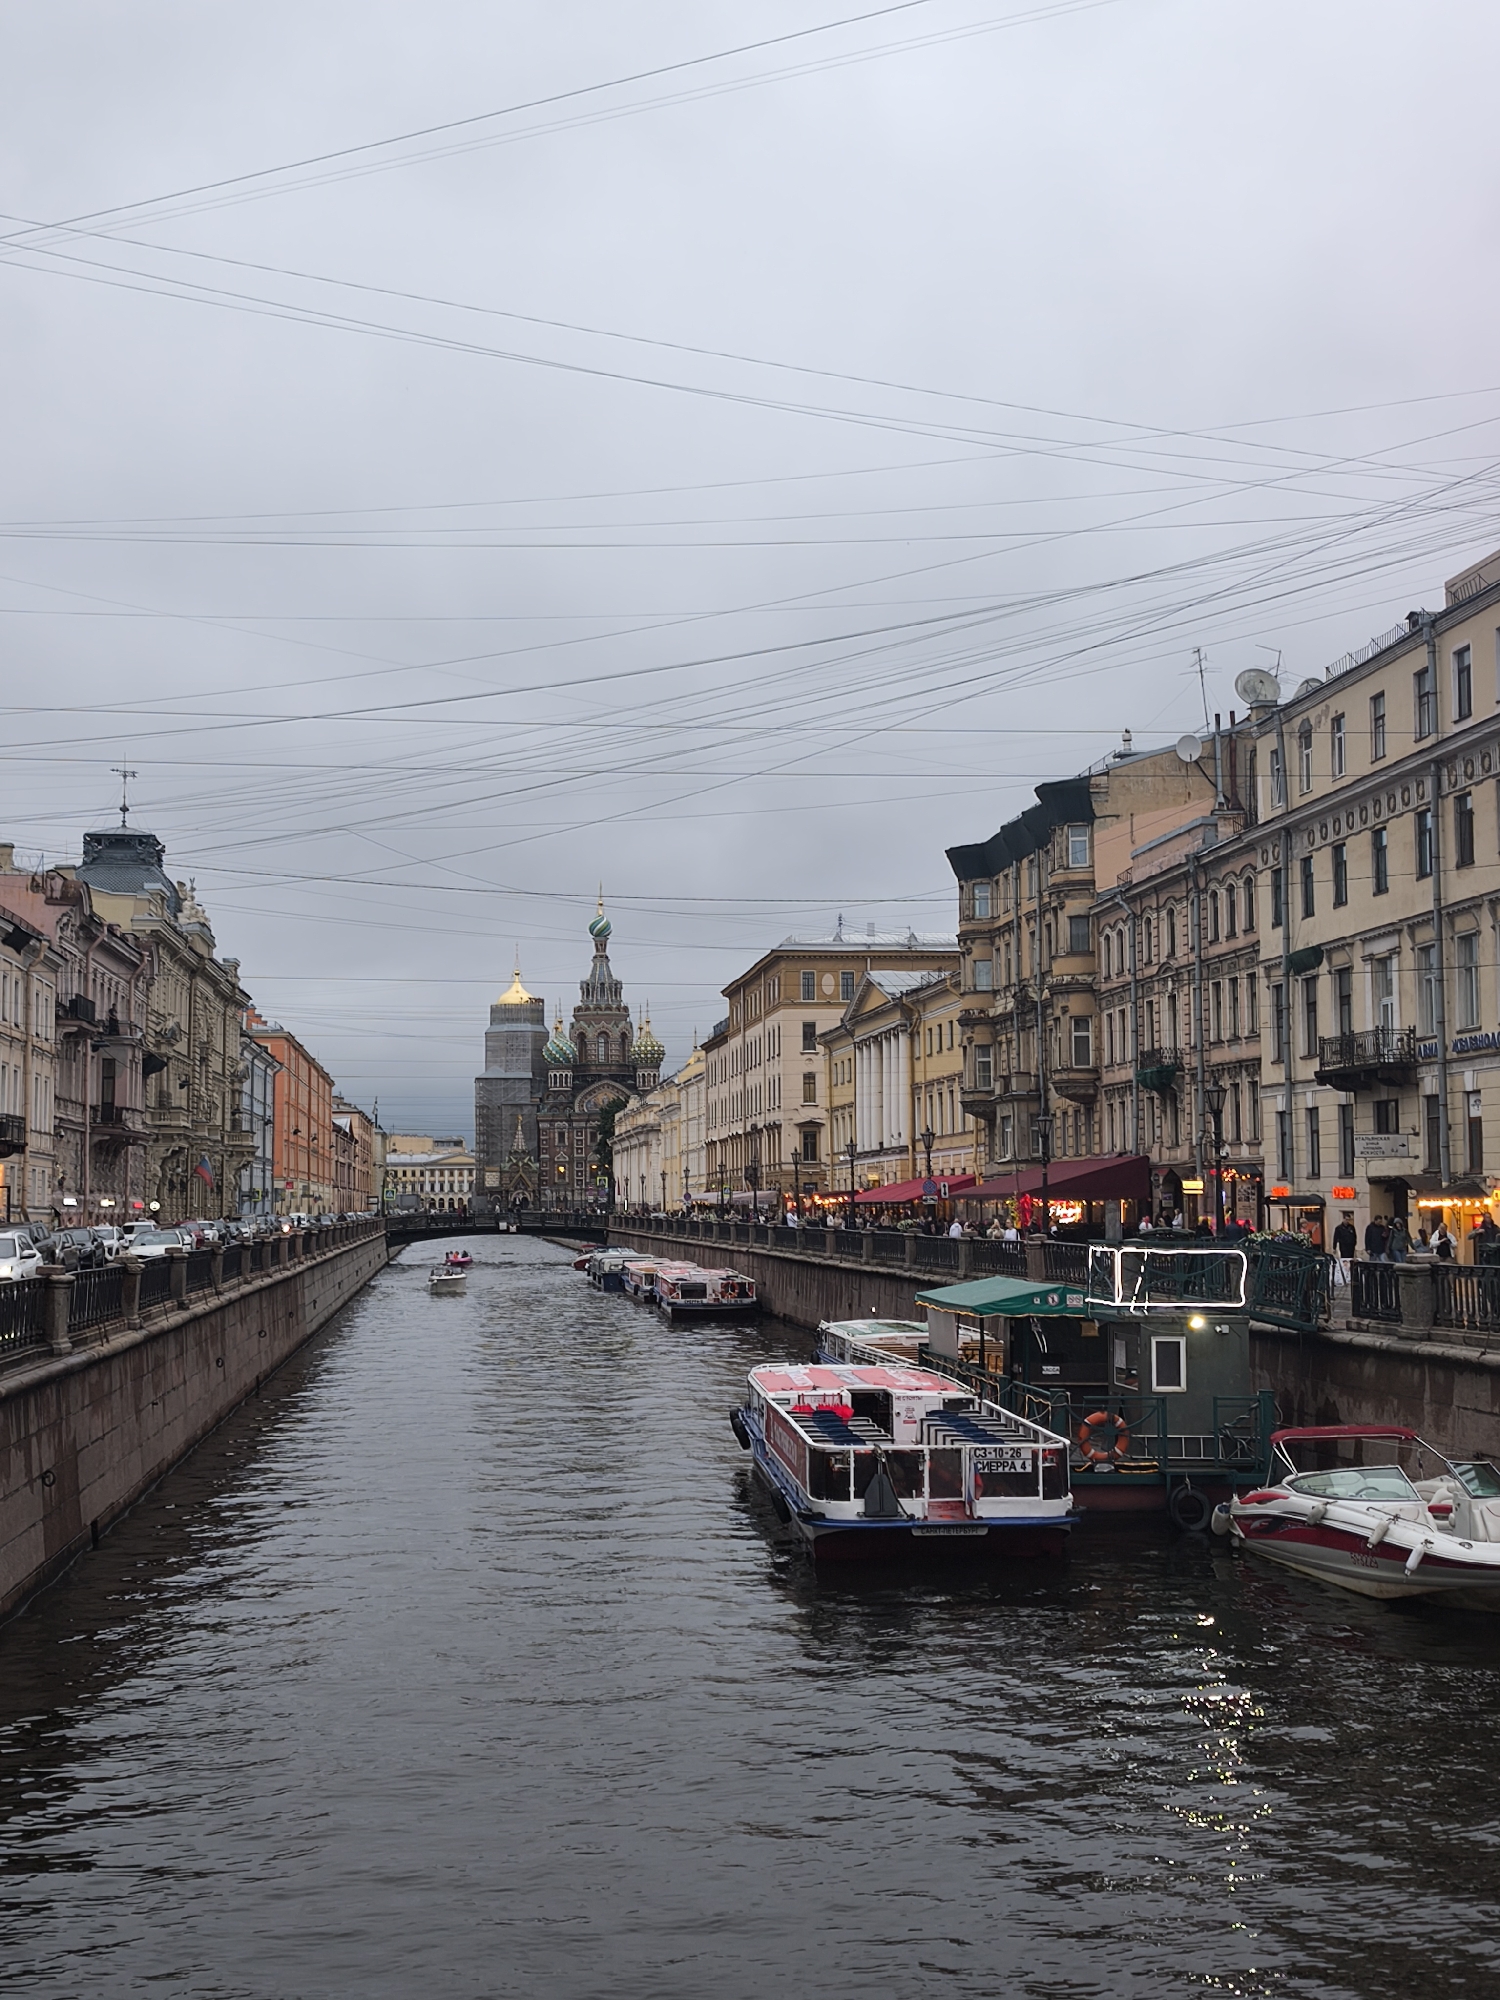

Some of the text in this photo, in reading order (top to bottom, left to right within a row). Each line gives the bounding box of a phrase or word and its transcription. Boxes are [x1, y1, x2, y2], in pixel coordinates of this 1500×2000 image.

[974, 1447, 1021, 1458] СЗ-10-26
[976, 1461, 1027, 1471] СИЕРРА 4
